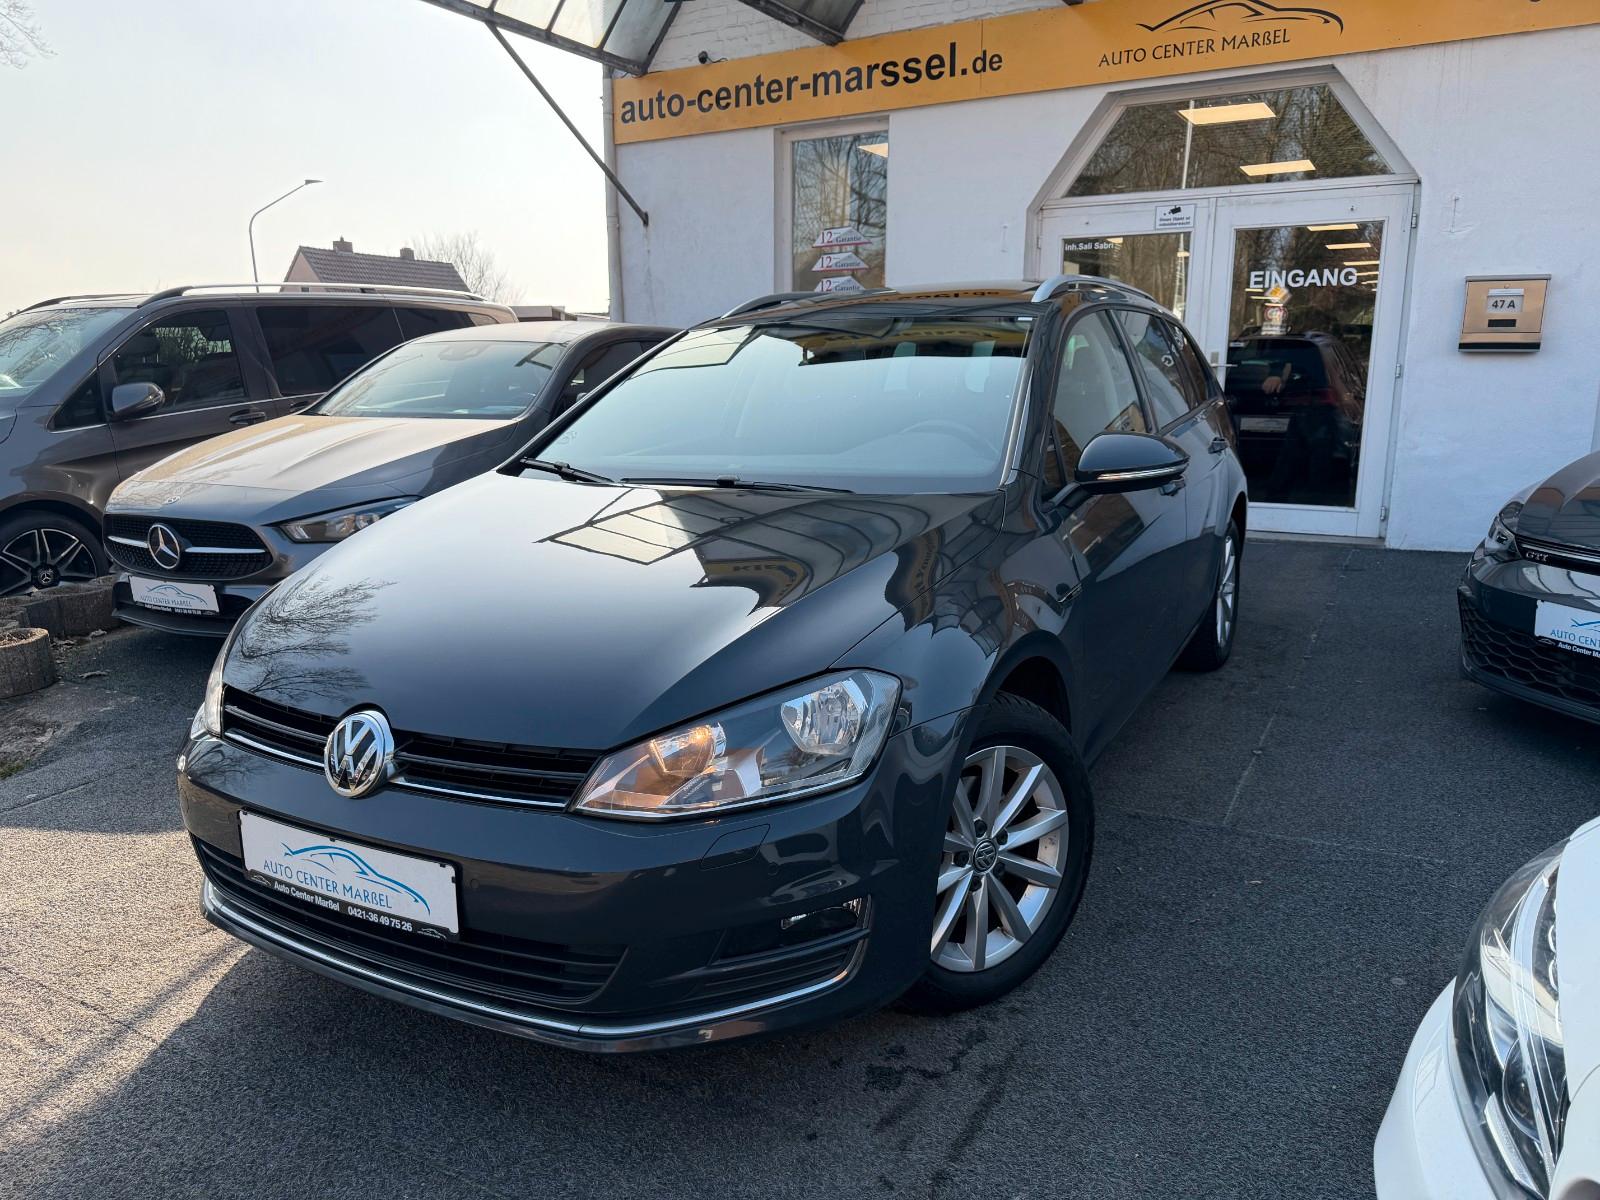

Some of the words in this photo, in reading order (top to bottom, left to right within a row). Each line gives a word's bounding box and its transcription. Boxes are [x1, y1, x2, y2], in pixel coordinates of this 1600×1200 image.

[1098, 47, 1147, 67] AUTO
[1152, 38, 1215, 60] CENTER
[1221, 28, 1290, 51] MARßEL
[621, 42, 1003, 124] auto-center-marssel.de
[821, 231, 833, 244] 12
[820, 255, 833, 268] 12
[820, 279, 833, 292] 12
[1249, 267, 1358, 289] EINGANG
[1549, 629, 1576, 641] AUTO
[1557, 641, 1572, 651] Auto
[1571, 645, 1592, 656] Center
[263, 859, 293, 879] AUTO
[296, 870, 339, 896] CENTER
[342, 884, 393, 909] MARßEL
[273, 880, 290, 895] Auto
[290, 887, 314, 903] Center
[314, 896, 340, 912] Marßel
[347, 905, 379, 924] 0421-36
[379, 914, 391, 927] 49
[390, 918, 401, 930] 75
[401, 921, 413, 932] 26
